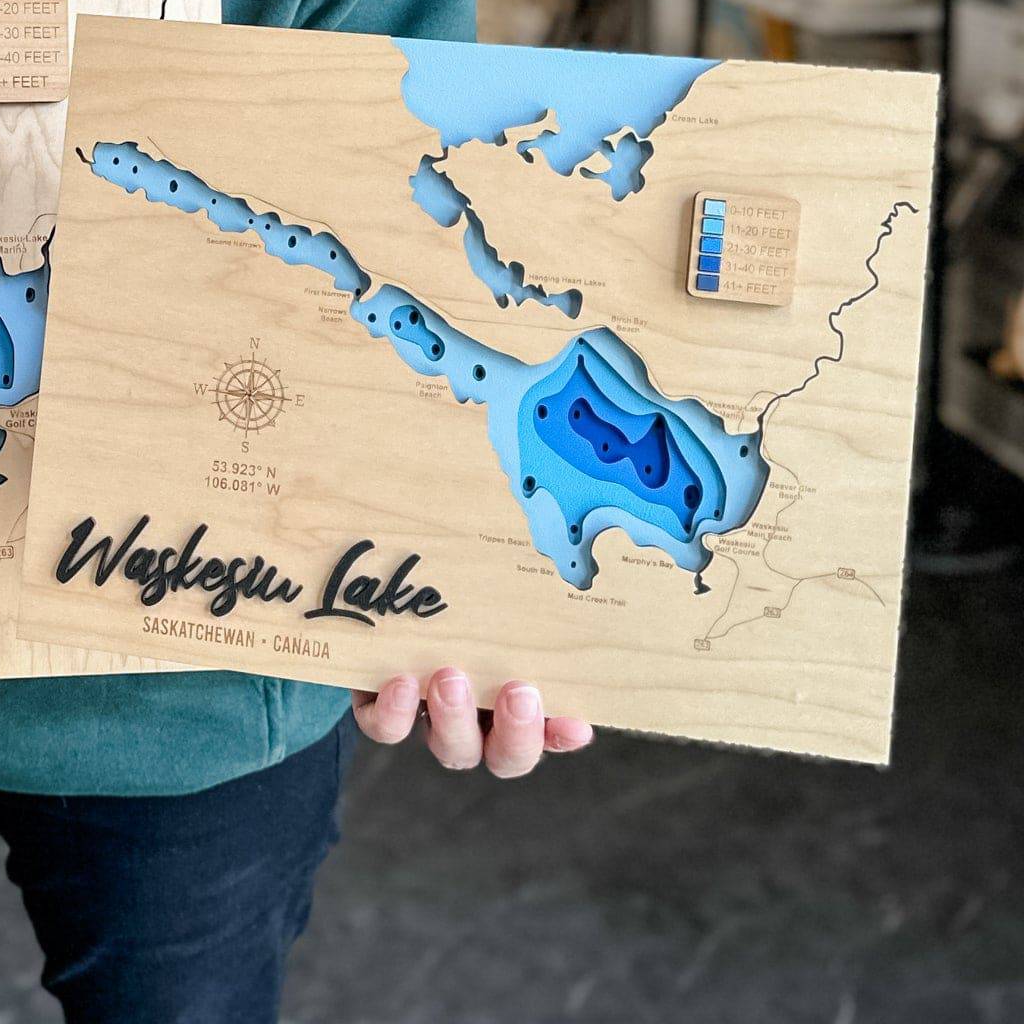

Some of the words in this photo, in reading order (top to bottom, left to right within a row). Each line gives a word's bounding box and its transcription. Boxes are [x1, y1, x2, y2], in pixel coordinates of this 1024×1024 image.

[23, 2, 60, 15] FEET
[24, 26, 60, 39] FEET
[24, 51, 61, 64] FEET
[12, 76, 49, 88] FEET
[756, 208, 788, 220] FEET
[762, 227, 792, 239] FEET
[760, 246, 791, 258] FEET
[758, 265, 789, 277] FEET
[746, 283, 777, 295] FEET
[249, 337, 261, 350] N
[193, 382, 208, 396] W
[295, 394, 305, 407] E
[10, 410, 38, 418] Wask
[5, 419, 25, 428] Golf
[241, 441, 250, 453] S
[266, 467, 277, 479] N
[267, 483, 281, 496] W
[55, 514, 303, 617] Waskesiu
[304, 539, 449, 628] Lake
[142, 615, 256, 650] SASKATCHEWAN
[273, 634, 331, 660] CANADA
